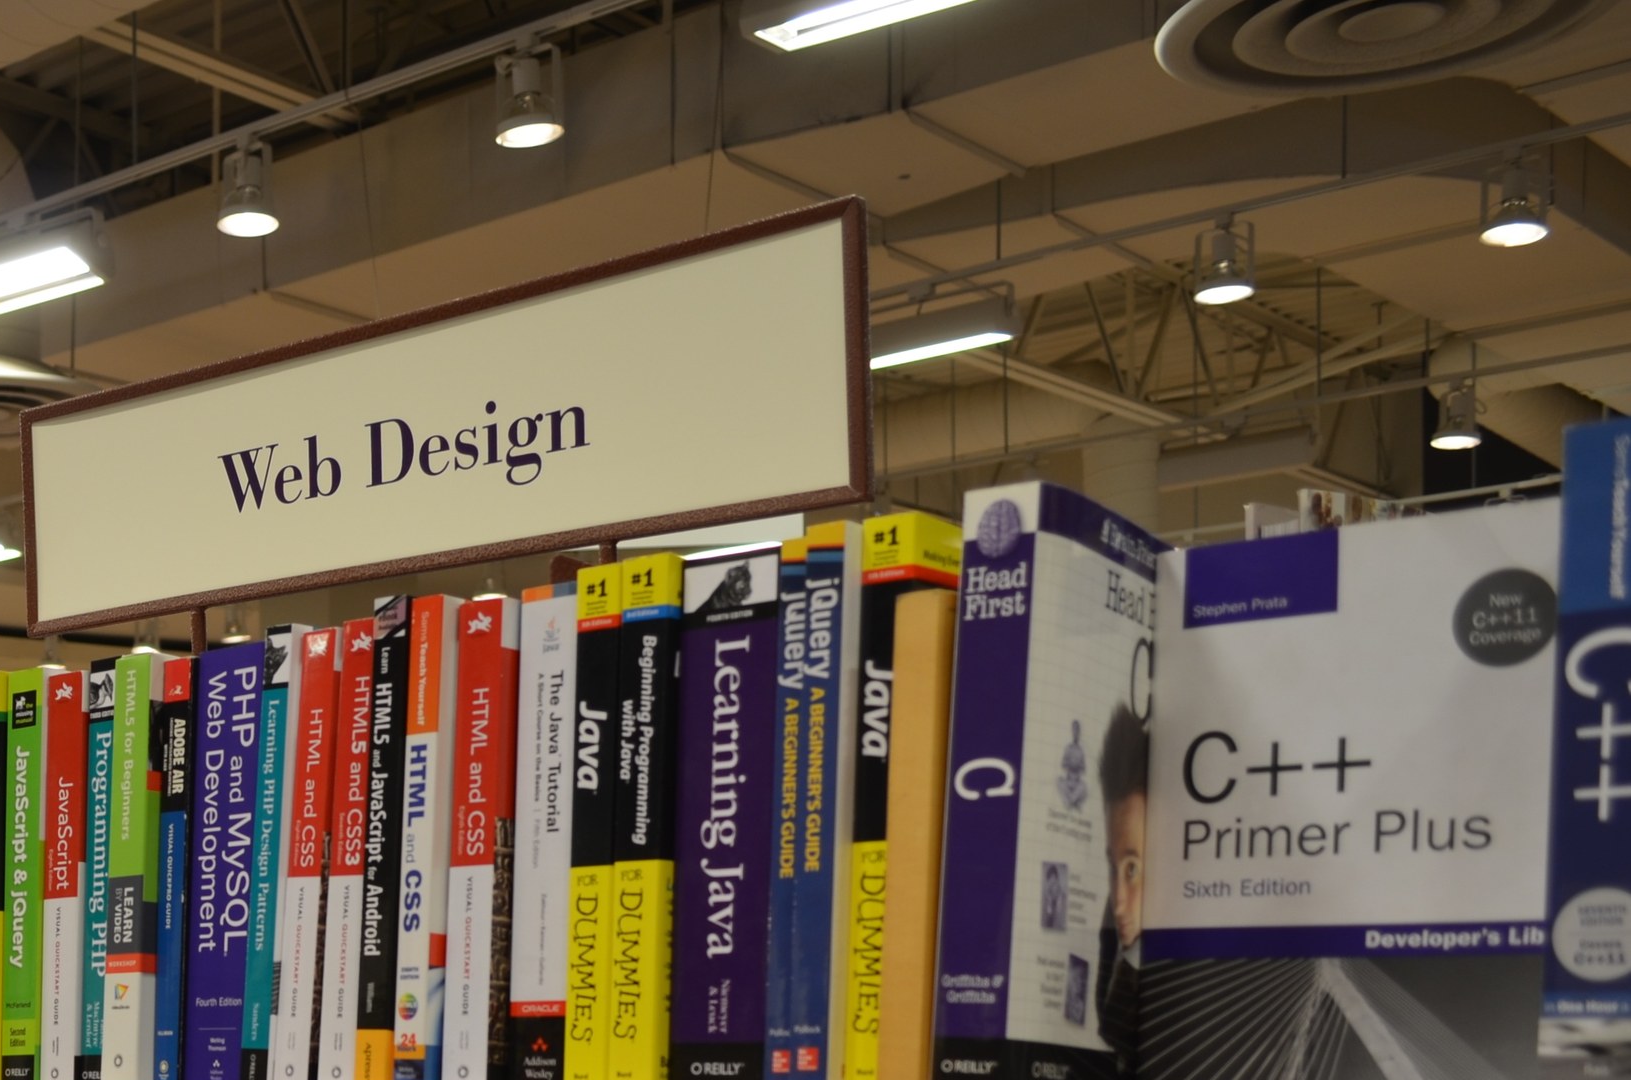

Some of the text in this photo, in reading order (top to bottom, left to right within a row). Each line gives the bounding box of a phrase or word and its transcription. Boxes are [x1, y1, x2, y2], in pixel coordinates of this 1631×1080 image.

[219, 401, 590, 514] Web Design
[963, 592, 1026, 621] First
[966, 562, 1027, 593] Head
[1192, 596, 1288, 619] Stephen Prata
[467, 688, 489, 856] HTML and CSS
[576, 701, 608, 792] Java
[804, 577, 839, 872] jQuery A BEGINNER'S GUIDE
[1182, 731, 1372, 804] C++
[199, 671, 227, 953] Web Development
[223, 666, 257, 956] PHP and MySQL
[255, 699, 280, 952] Learning PHP Design Patterns
[363, 646, 392, 957] Learn HTML5 and JavaScript for Android
[699, 635, 751, 959] Learning Java
[953, 757, 1013, 800] C
[10, 747, 30, 968] JavaScript & jQuery
[90, 732, 111, 976] Programming PHP
[1182, 810, 1492, 860] Primer Plus
[123, 886, 134, 944] LEARN
[1183, 879, 1312, 898] Sixth Edition
[1366, 929, 1501, 950] Developer's
[521, 1004, 559, 1013] ORACLE
[570, 893, 598, 1044] DUMMIES
